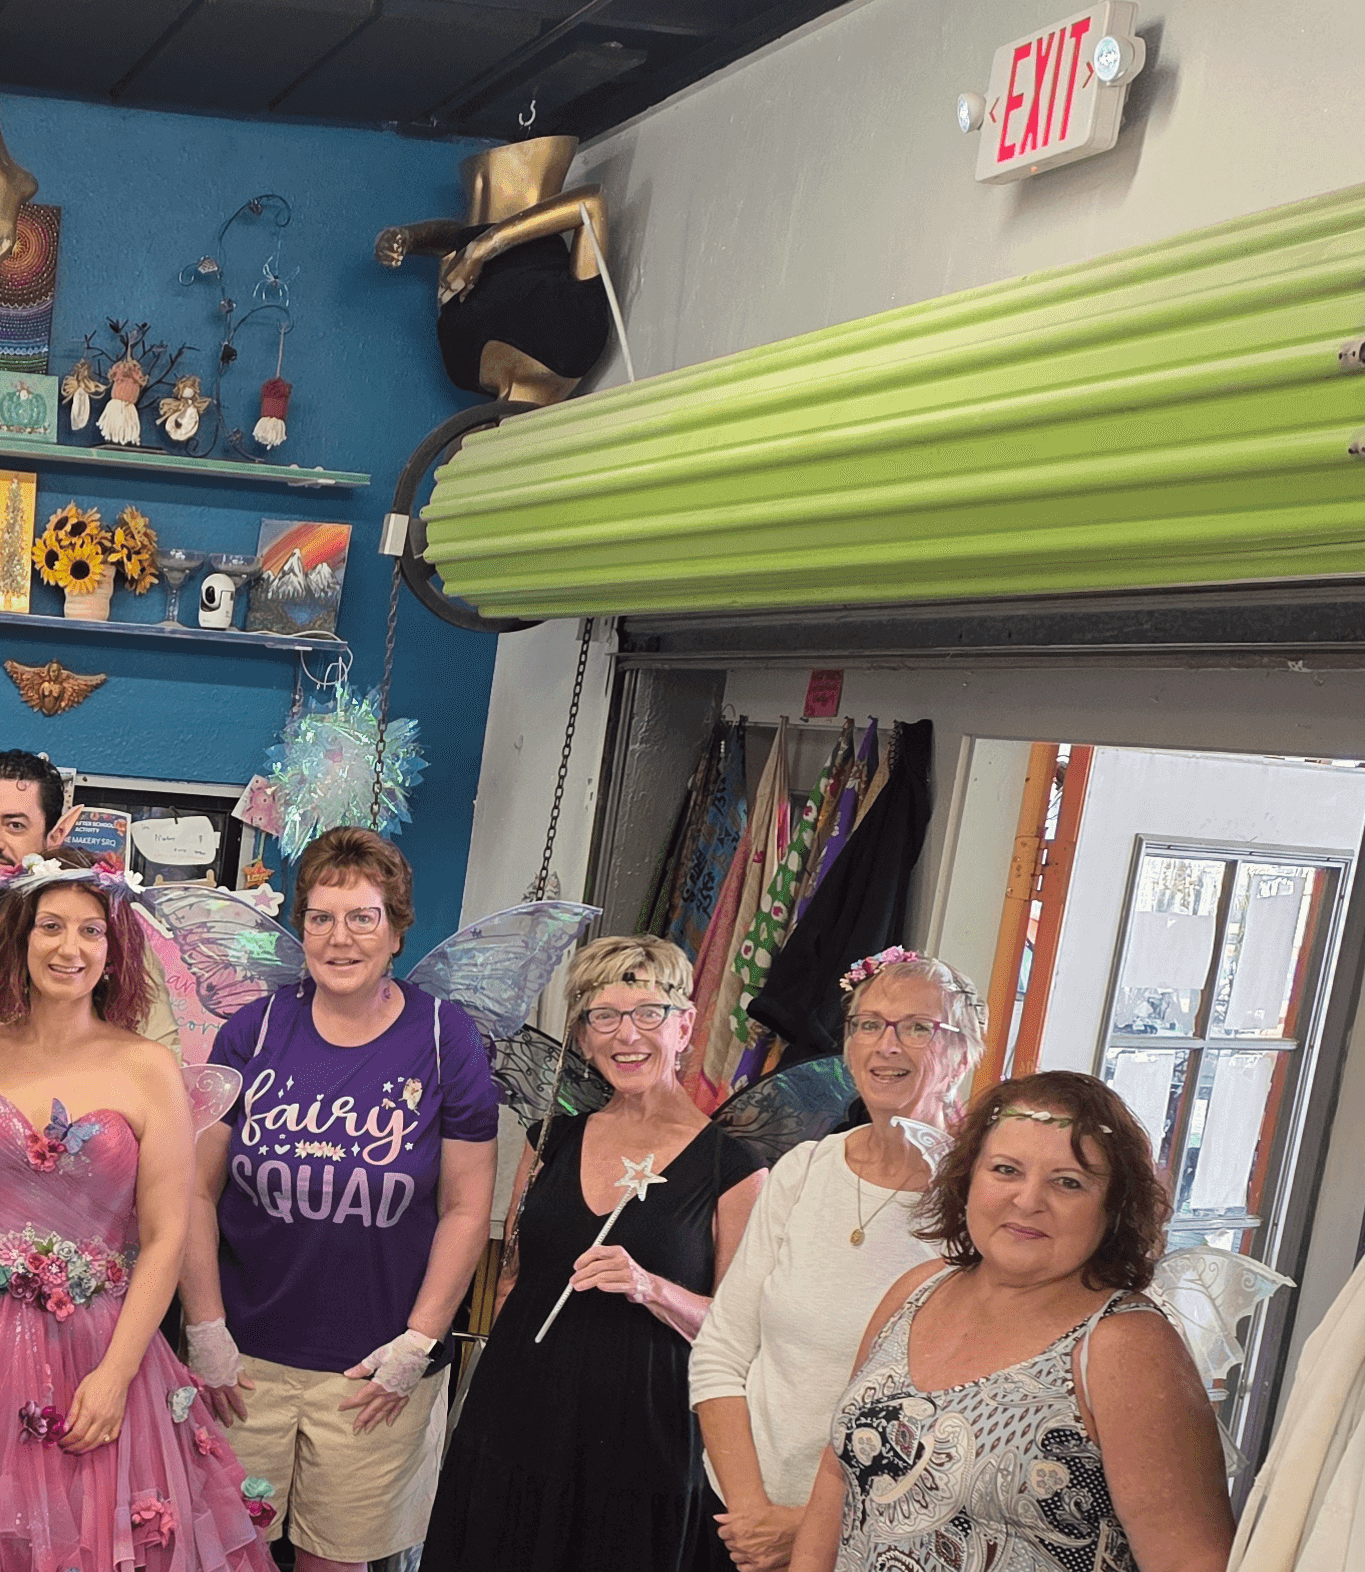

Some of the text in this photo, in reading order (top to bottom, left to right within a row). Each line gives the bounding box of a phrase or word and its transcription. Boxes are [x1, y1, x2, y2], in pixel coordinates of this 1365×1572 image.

[997, 16, 1092, 163] EXIT
[72, 837, 100, 846] MAKERY
[101, 838, 117, 848] SRQ
[241, 1069, 418, 1166] fairy
[232, 1154, 415, 1229] SQUAD
